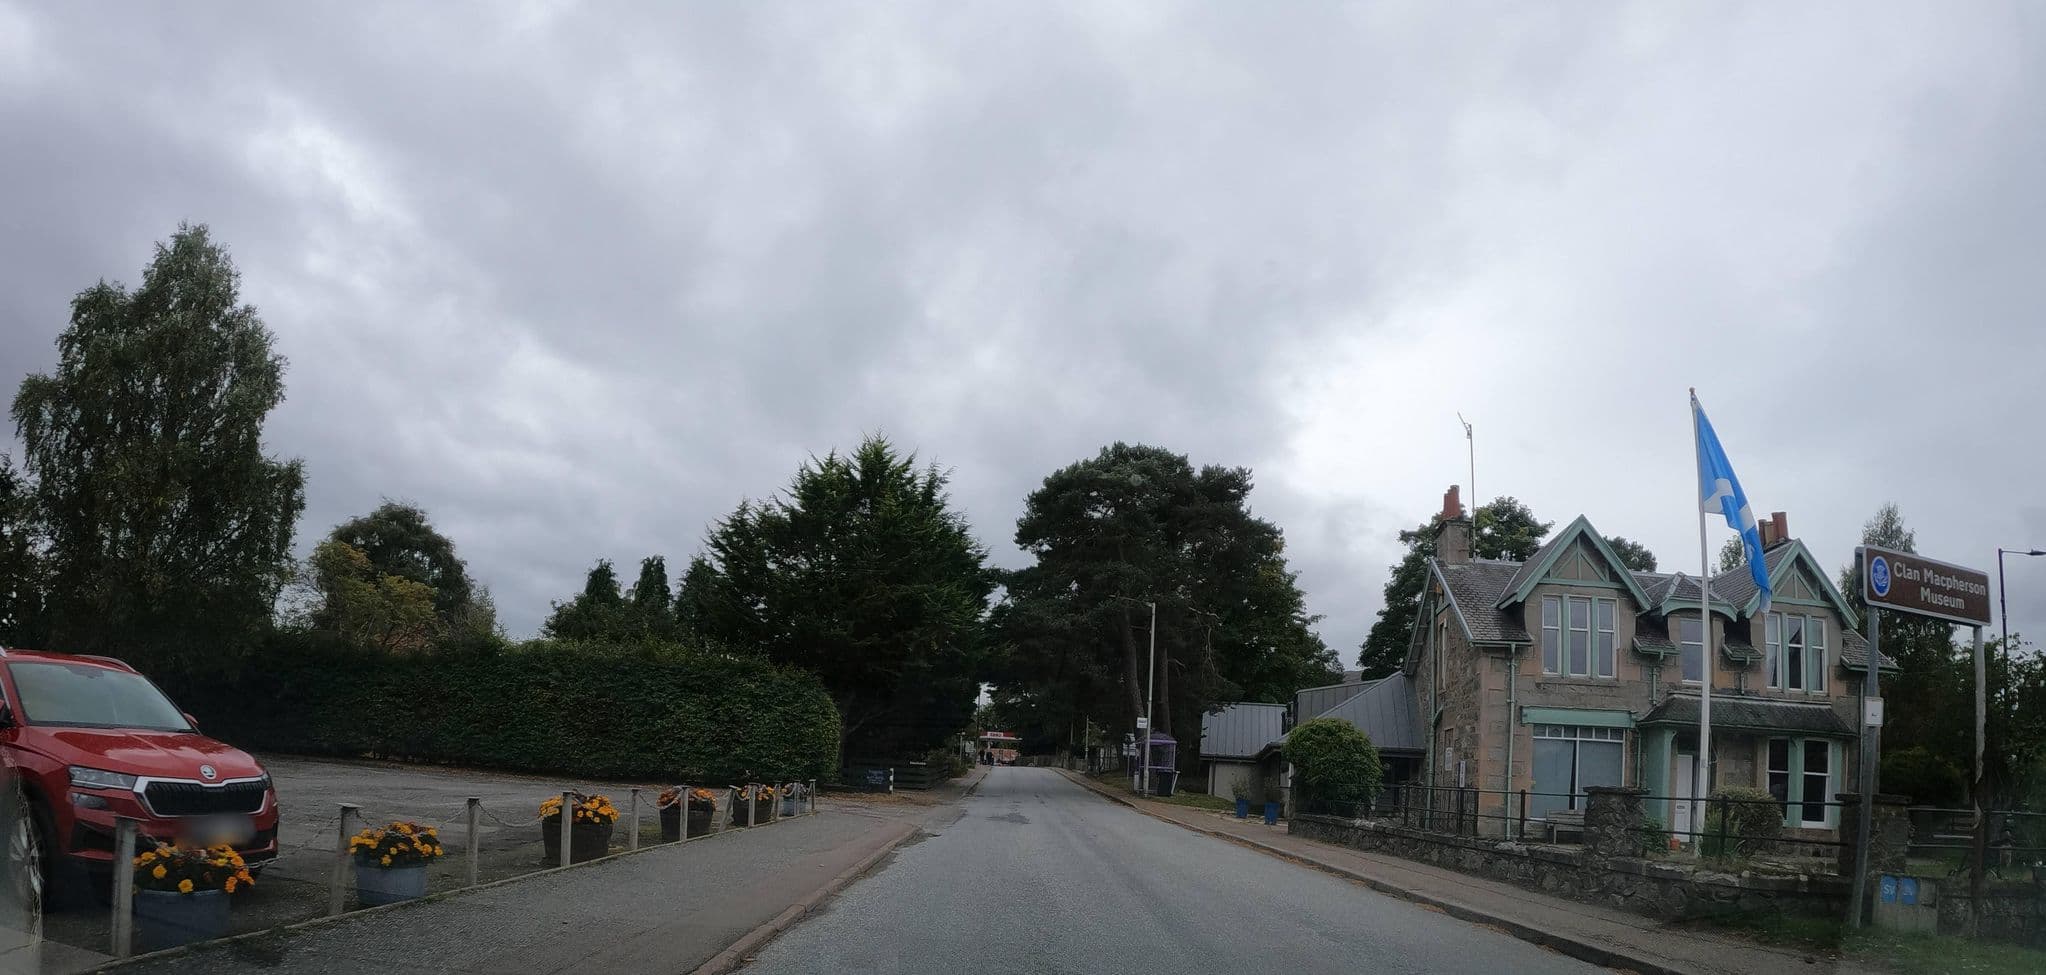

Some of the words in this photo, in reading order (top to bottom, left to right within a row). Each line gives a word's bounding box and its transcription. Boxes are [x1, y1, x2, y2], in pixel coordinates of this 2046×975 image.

[1893, 562, 1921, 582] Clan
[1923, 569, 1986, 596] Macpherson
[1920, 587, 1965, 610] Museum
